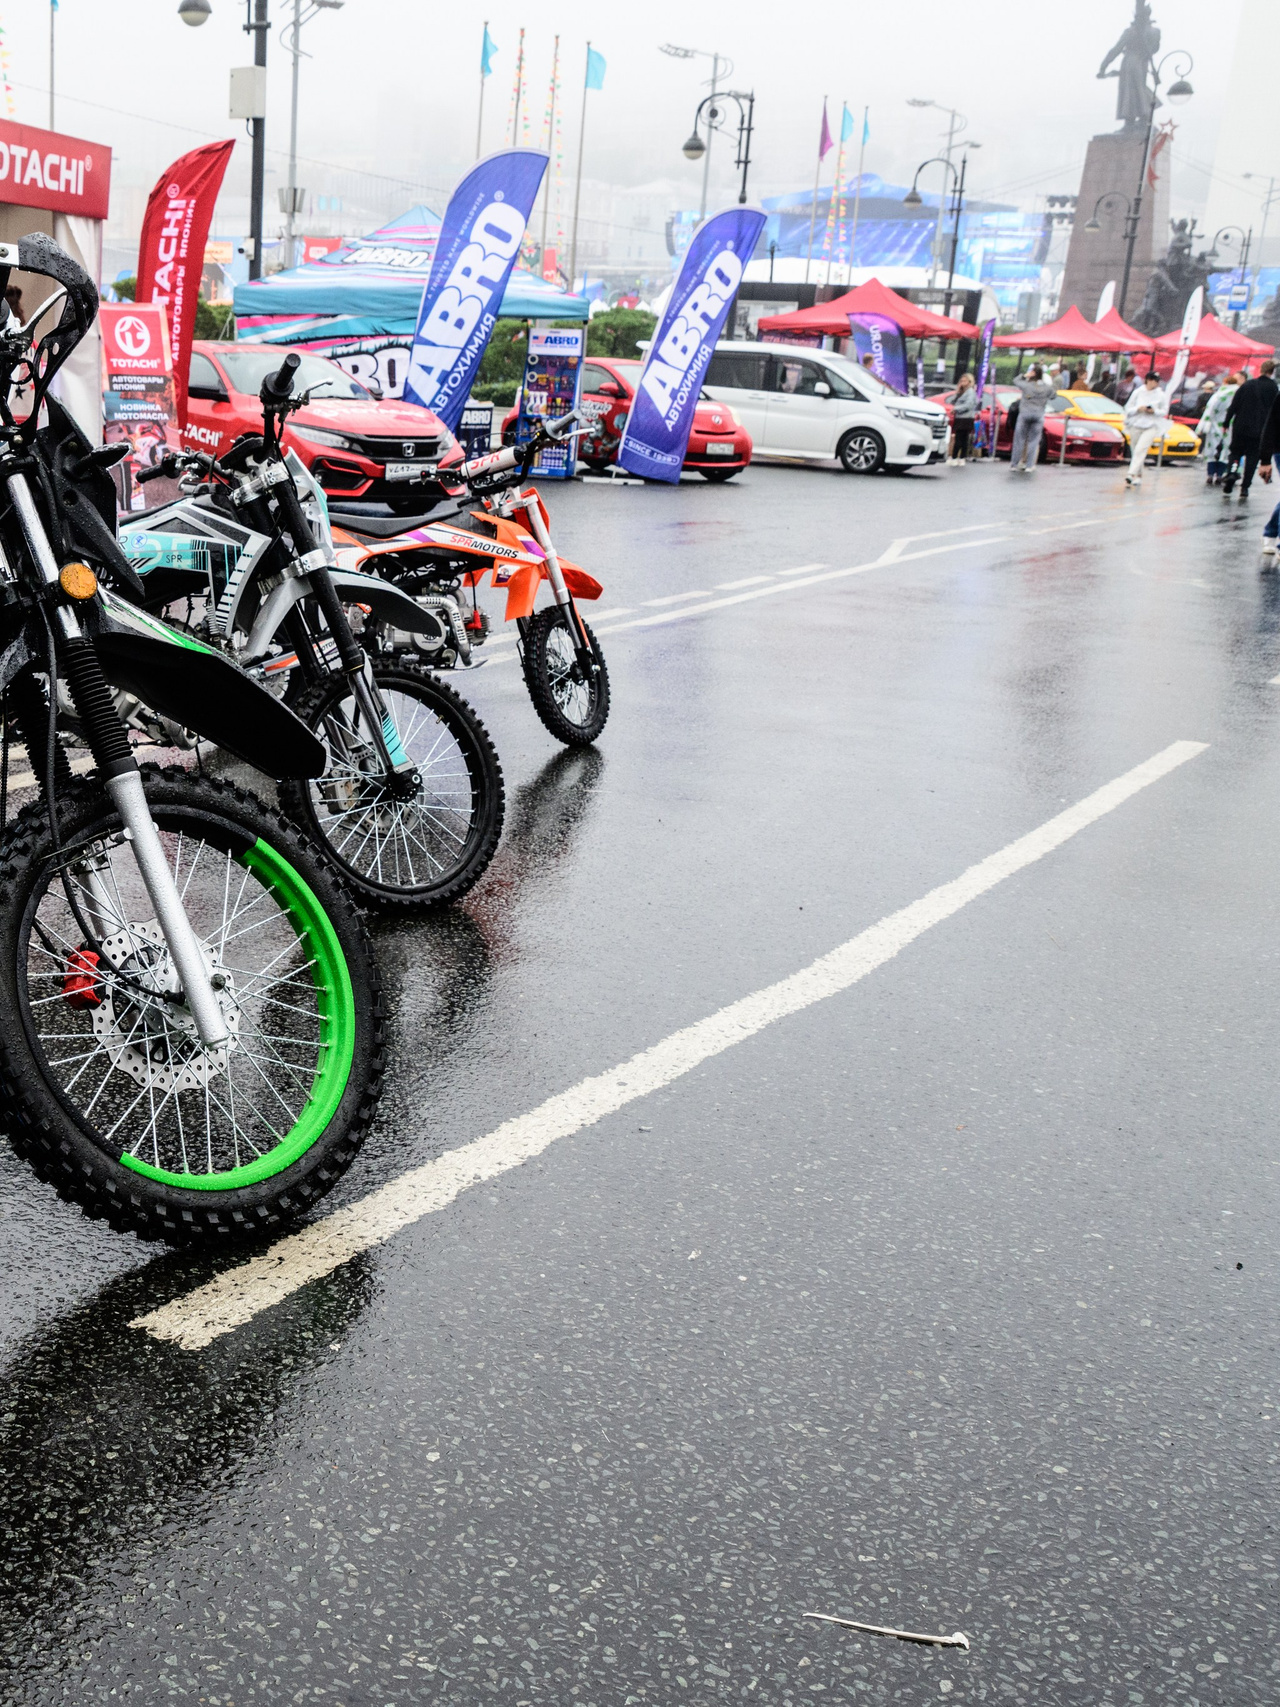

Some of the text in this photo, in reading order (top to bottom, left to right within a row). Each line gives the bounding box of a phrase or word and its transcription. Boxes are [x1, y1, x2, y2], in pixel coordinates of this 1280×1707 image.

[151, 199, 187, 305] TACHI
[344, 246, 429, 267] ABRO
[171, 199, 197, 361] АВТОТОВАРЫ ЯПОНИЯ
[407, 200, 526, 406] ABRO
[544, 335, 579, 345] ABRO
[641, 249, 743, 418] ABRO
[110, 358, 159, 369] TOTACHI
[428, 312, 496, 417] АВТОХИМИЯ
[112, 376, 164, 384] АВТОТОВАРЫ
[663, 343, 714, 433] АВТОХИМИЯ
[114, 413, 170, 421] МОТОМАСЛА
[120, 404, 162, 412] НОВИНКА
[461, 410, 491, 424] ABRO
[470, 450, 500, 469] SPR
[449, 534, 519, 559] SPRMOTORS
[165, 554, 183, 563] SPR
